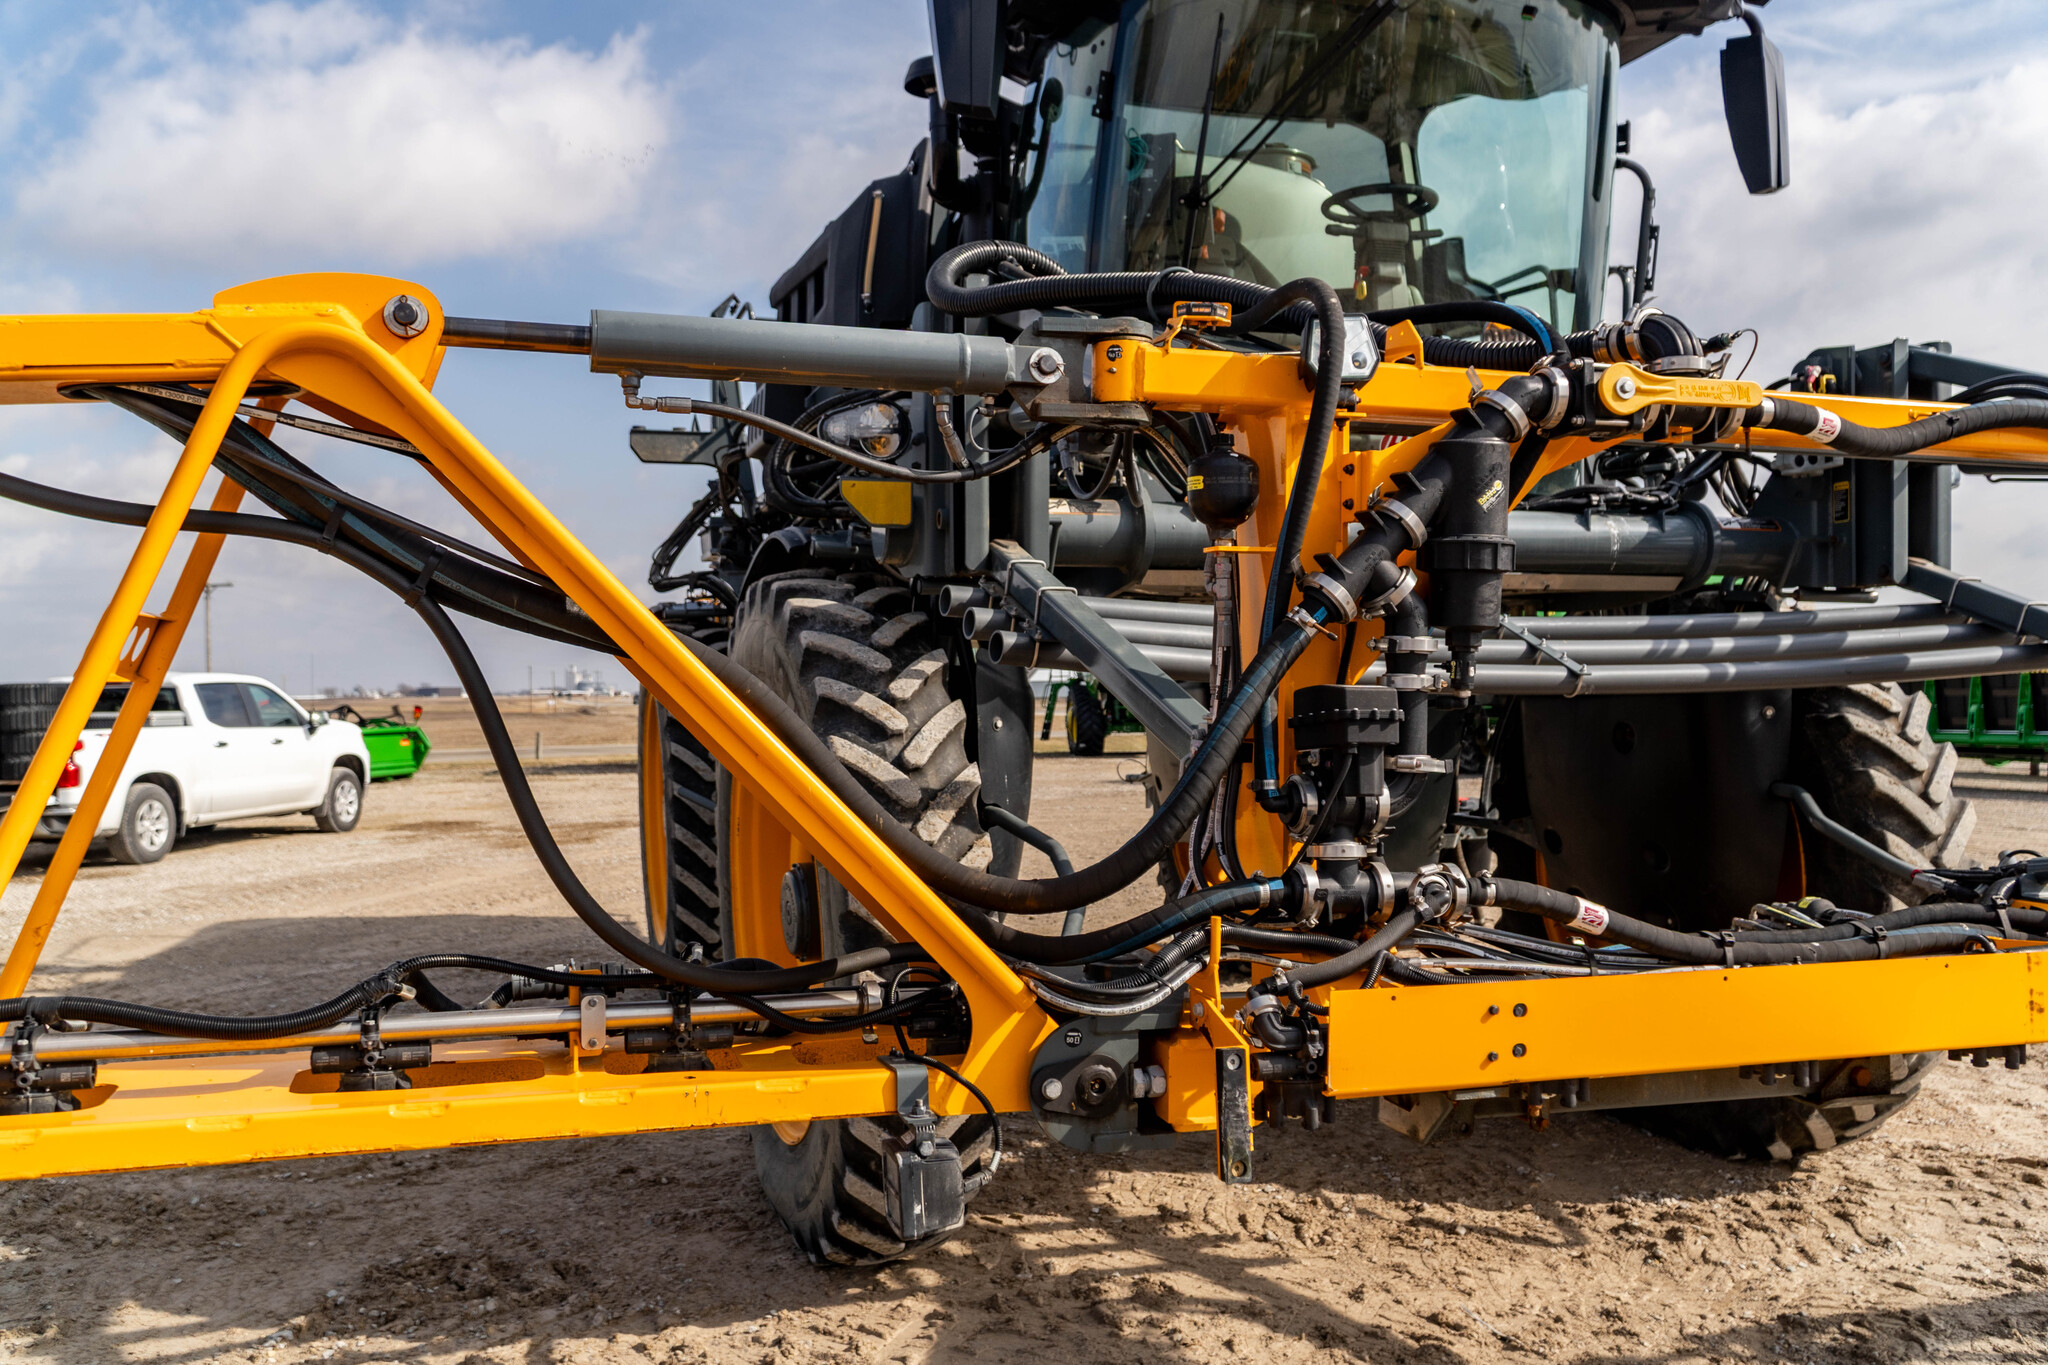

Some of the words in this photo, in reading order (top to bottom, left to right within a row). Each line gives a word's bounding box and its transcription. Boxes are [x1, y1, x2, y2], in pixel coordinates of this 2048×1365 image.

[146, 387, 163, 395] MPa
[163, 390, 185, 400] (3000
[186, 395, 202, 404] PSI)
